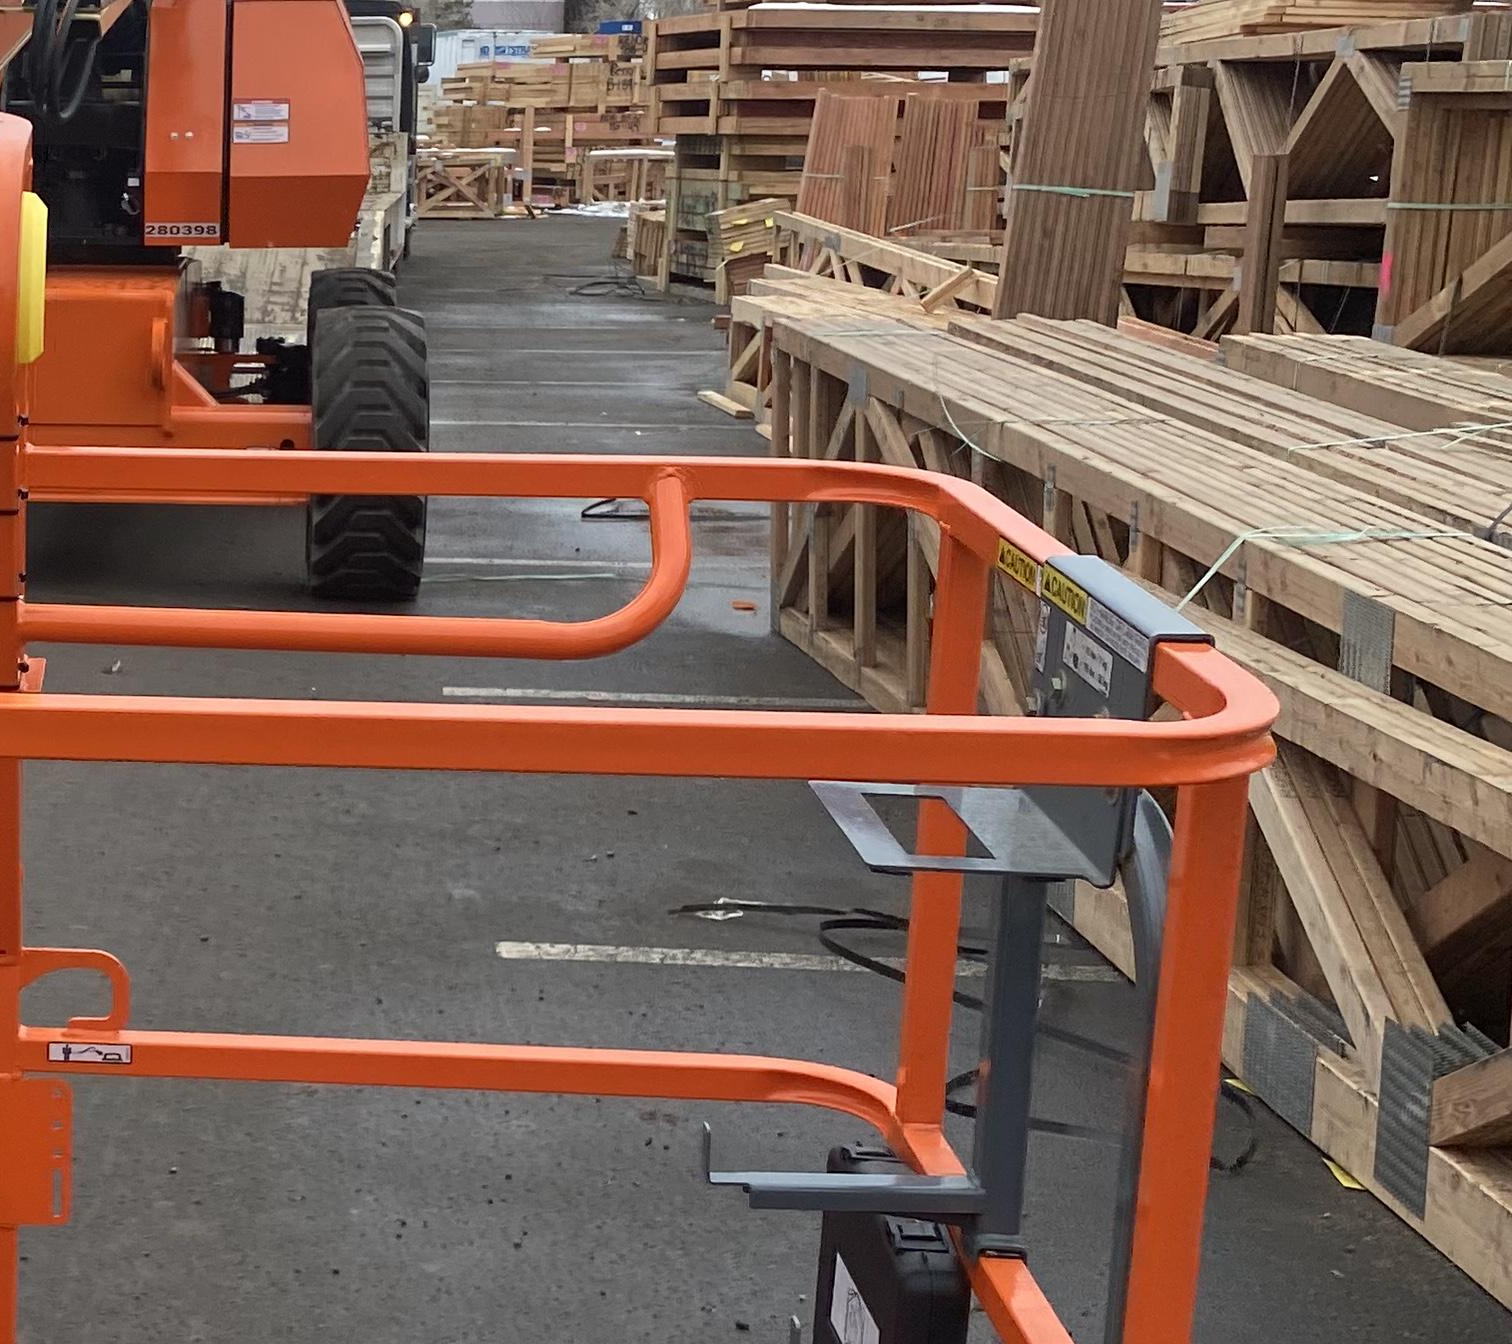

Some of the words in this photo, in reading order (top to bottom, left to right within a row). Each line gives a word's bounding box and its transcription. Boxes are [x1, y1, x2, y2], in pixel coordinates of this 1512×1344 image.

[145, 225, 218, 236] 280398
[1006, 548, 1037, 584] CAUTION
[1050, 576, 1086, 618] CAUTION
